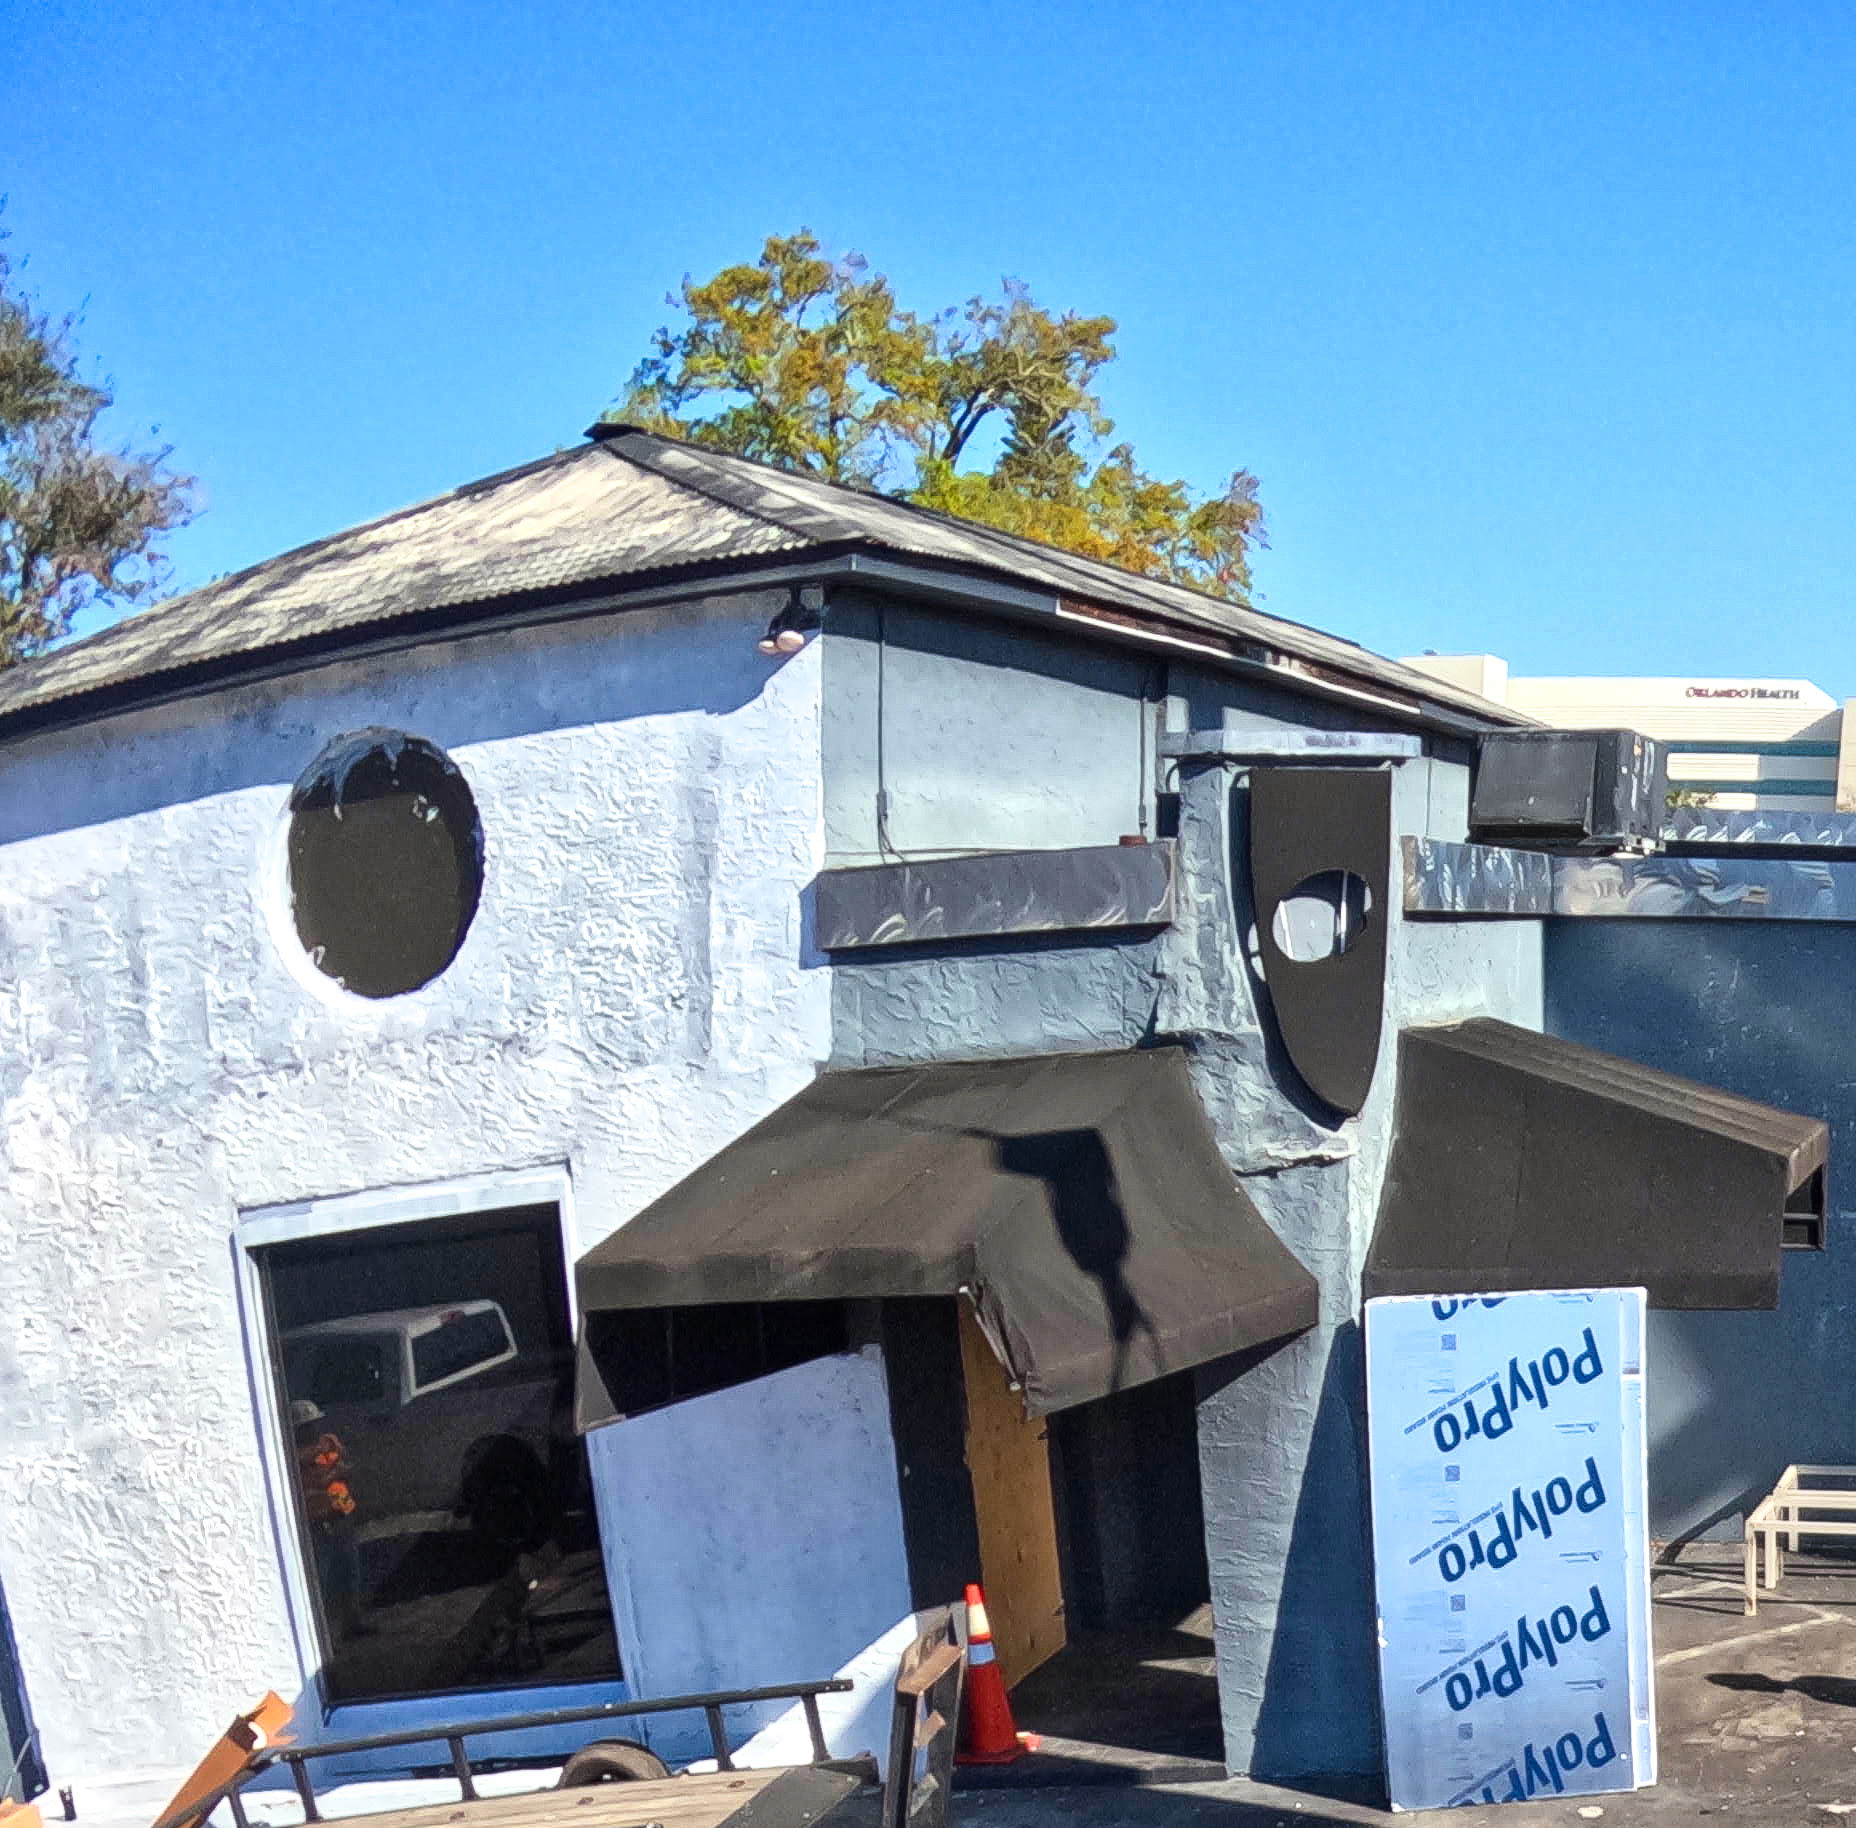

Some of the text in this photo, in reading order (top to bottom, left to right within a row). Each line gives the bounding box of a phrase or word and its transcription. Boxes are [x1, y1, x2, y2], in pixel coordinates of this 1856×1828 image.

[1433, 1327, 1603, 1453] PolyPro
[1438, 1456, 1606, 1582] PolyPro
[1445, 1584, 1611, 1711] PolyPro
